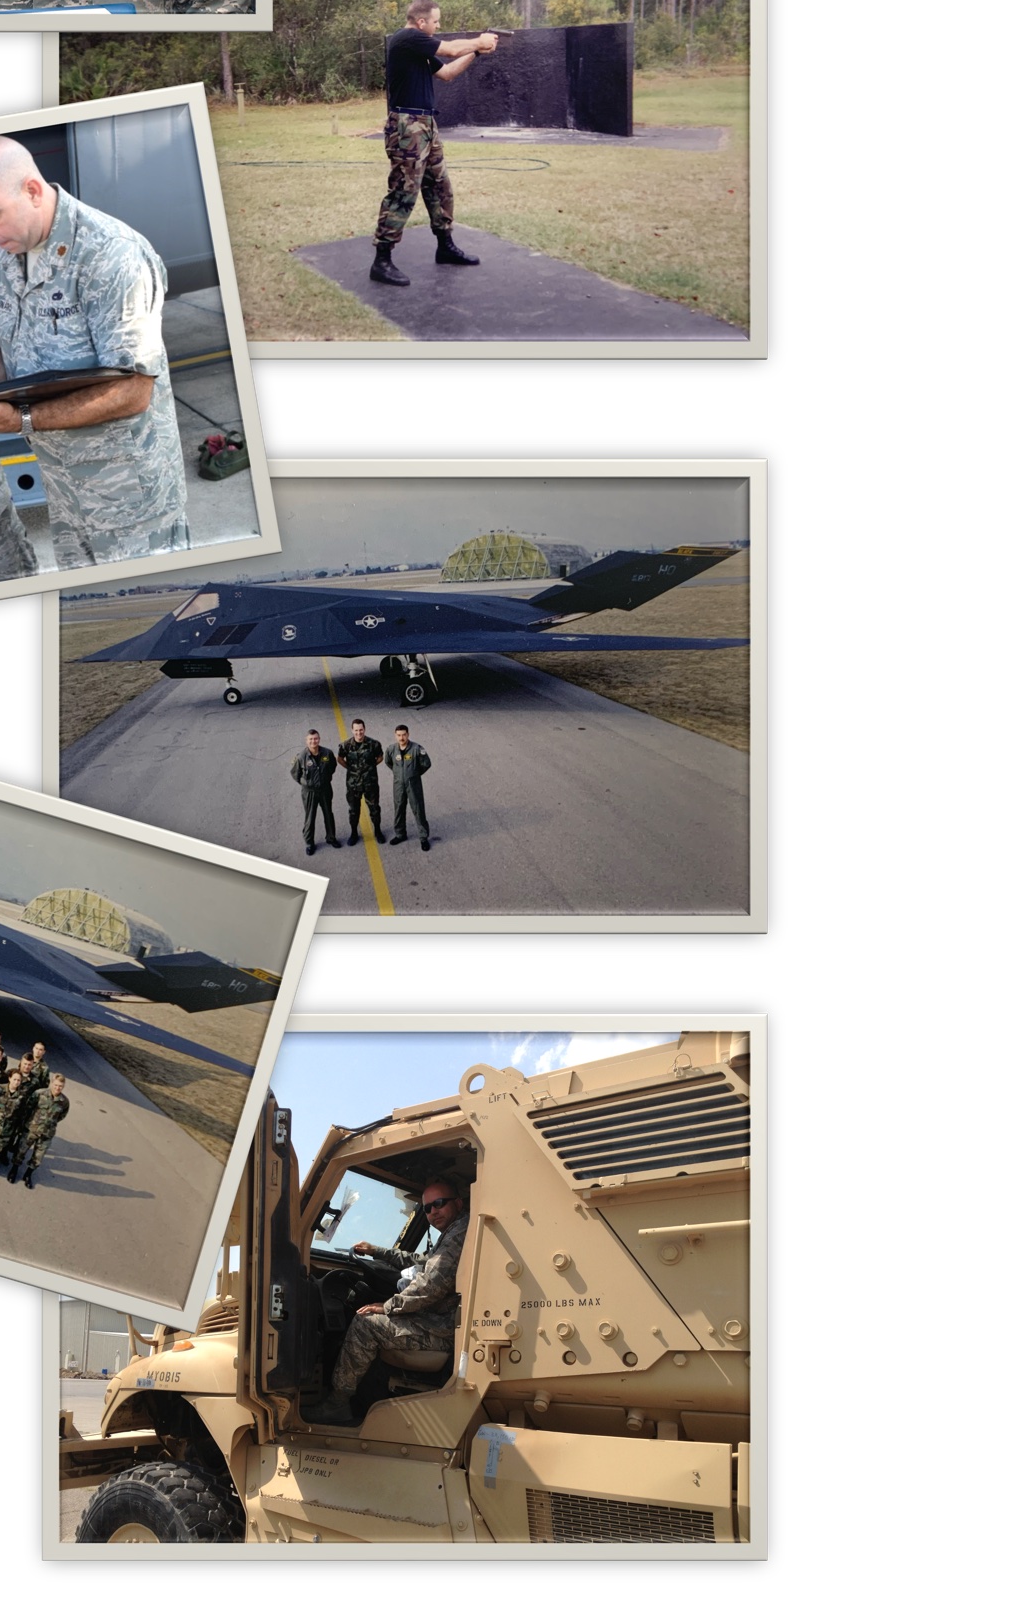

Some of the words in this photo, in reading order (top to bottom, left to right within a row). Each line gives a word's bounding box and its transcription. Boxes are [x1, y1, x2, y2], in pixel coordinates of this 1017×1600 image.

[488, 1092, 507, 1104] LIFT
[521, 1300, 552, 1309] 25000
[555, 1298, 574, 1308] LBS
[578, 1297, 601, 1307] MAX
[481, 1319, 502, 1327] DOWN
[304, 1454, 327, 1464] DIESEL
[329, 1458, 340, 1466] OR
[314, 1468, 333, 1478] ONLY
